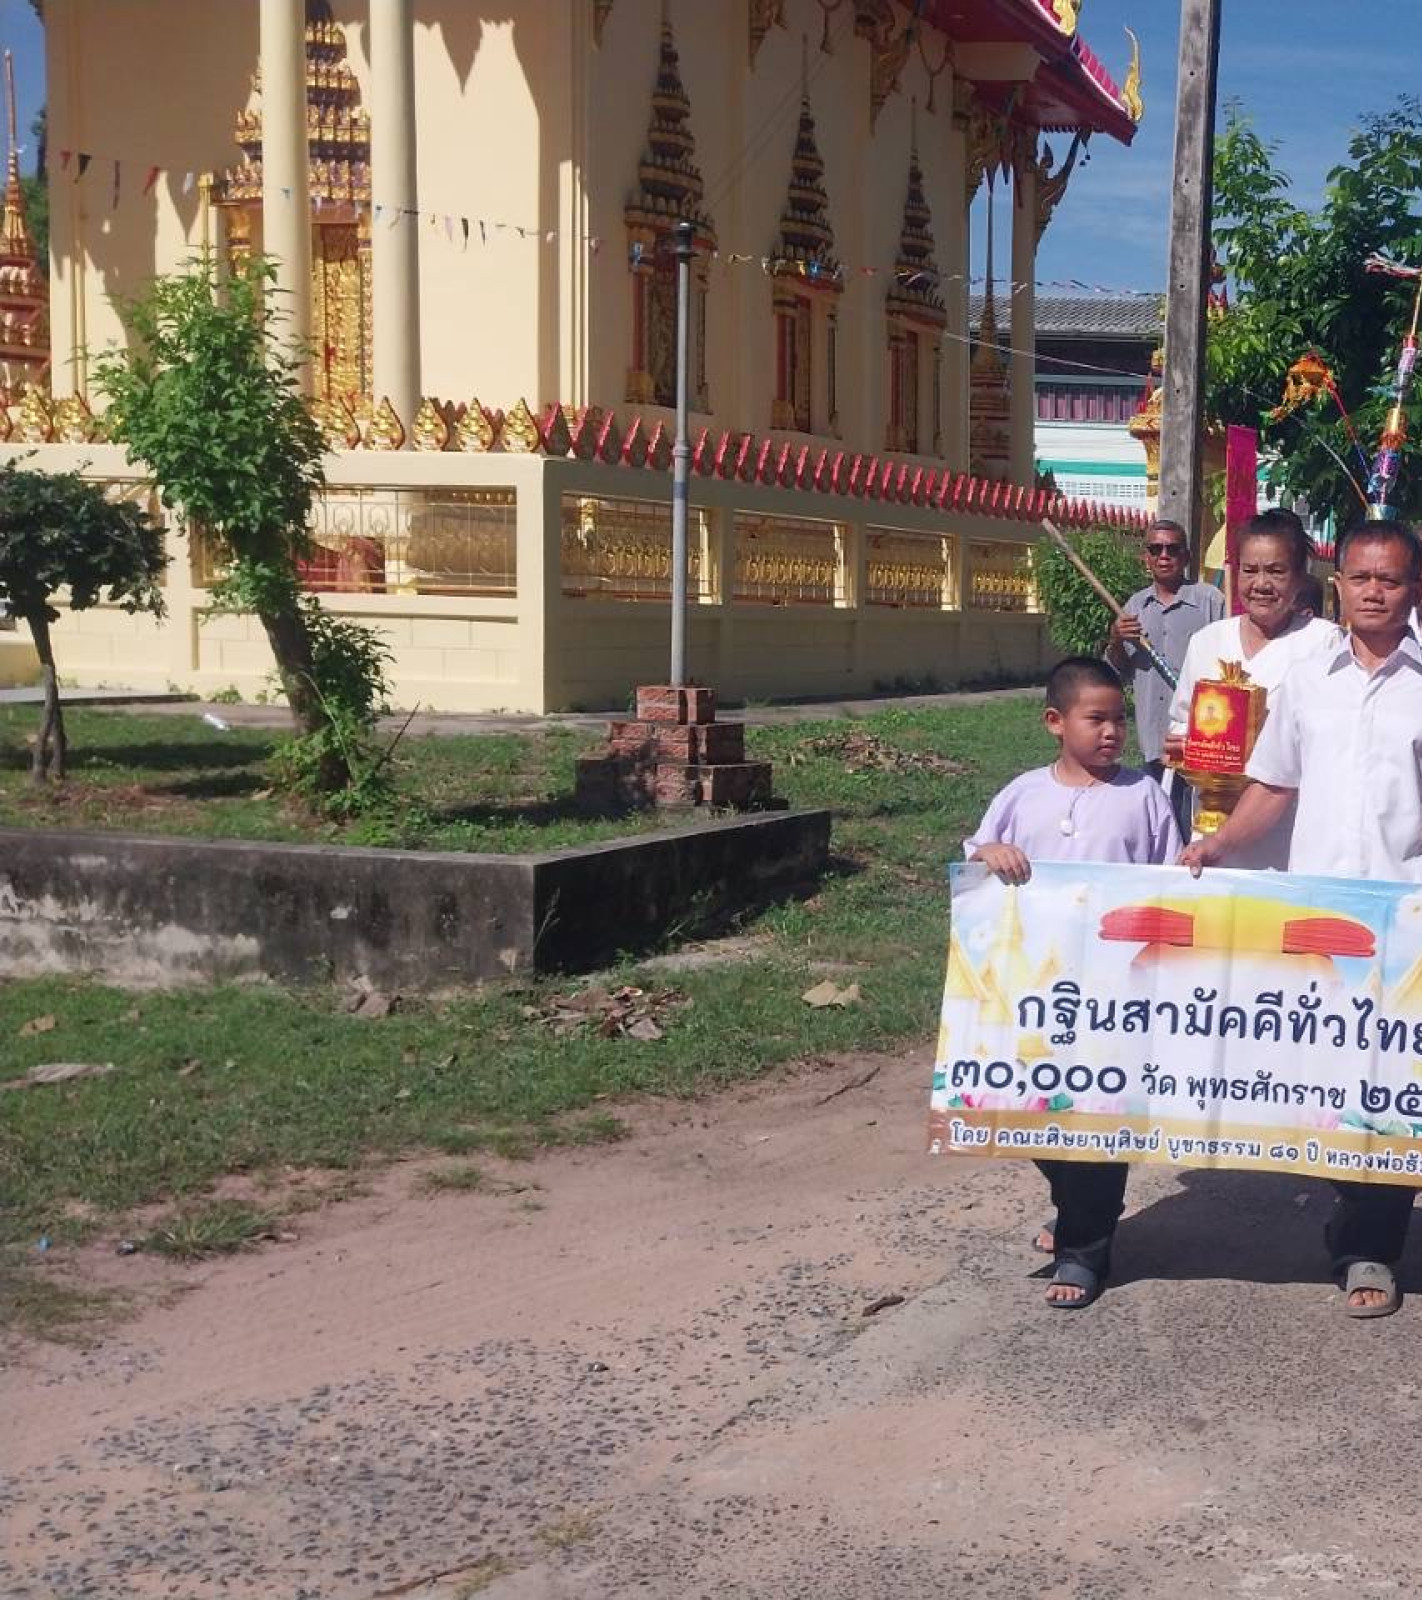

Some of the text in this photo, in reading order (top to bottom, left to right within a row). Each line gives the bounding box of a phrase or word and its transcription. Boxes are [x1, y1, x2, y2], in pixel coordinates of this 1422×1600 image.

[951, 1059, 1127, 1096] ๓๐,๐๐๐
[1141, 1062, 1176, 1096] วัด
[1187, 1069, 1346, 1111] พุทธศักราช
[952, 1121, 989, 1143] โดย
[997, 1126, 1160, 1155] คณะศิษยานุศิษย์
[1168, 1137, 1261, 1159] บูชาธรรม
[1269, 1144, 1299, 1160] ๘๑
[1306, 1140, 1319, 1162] ปี
